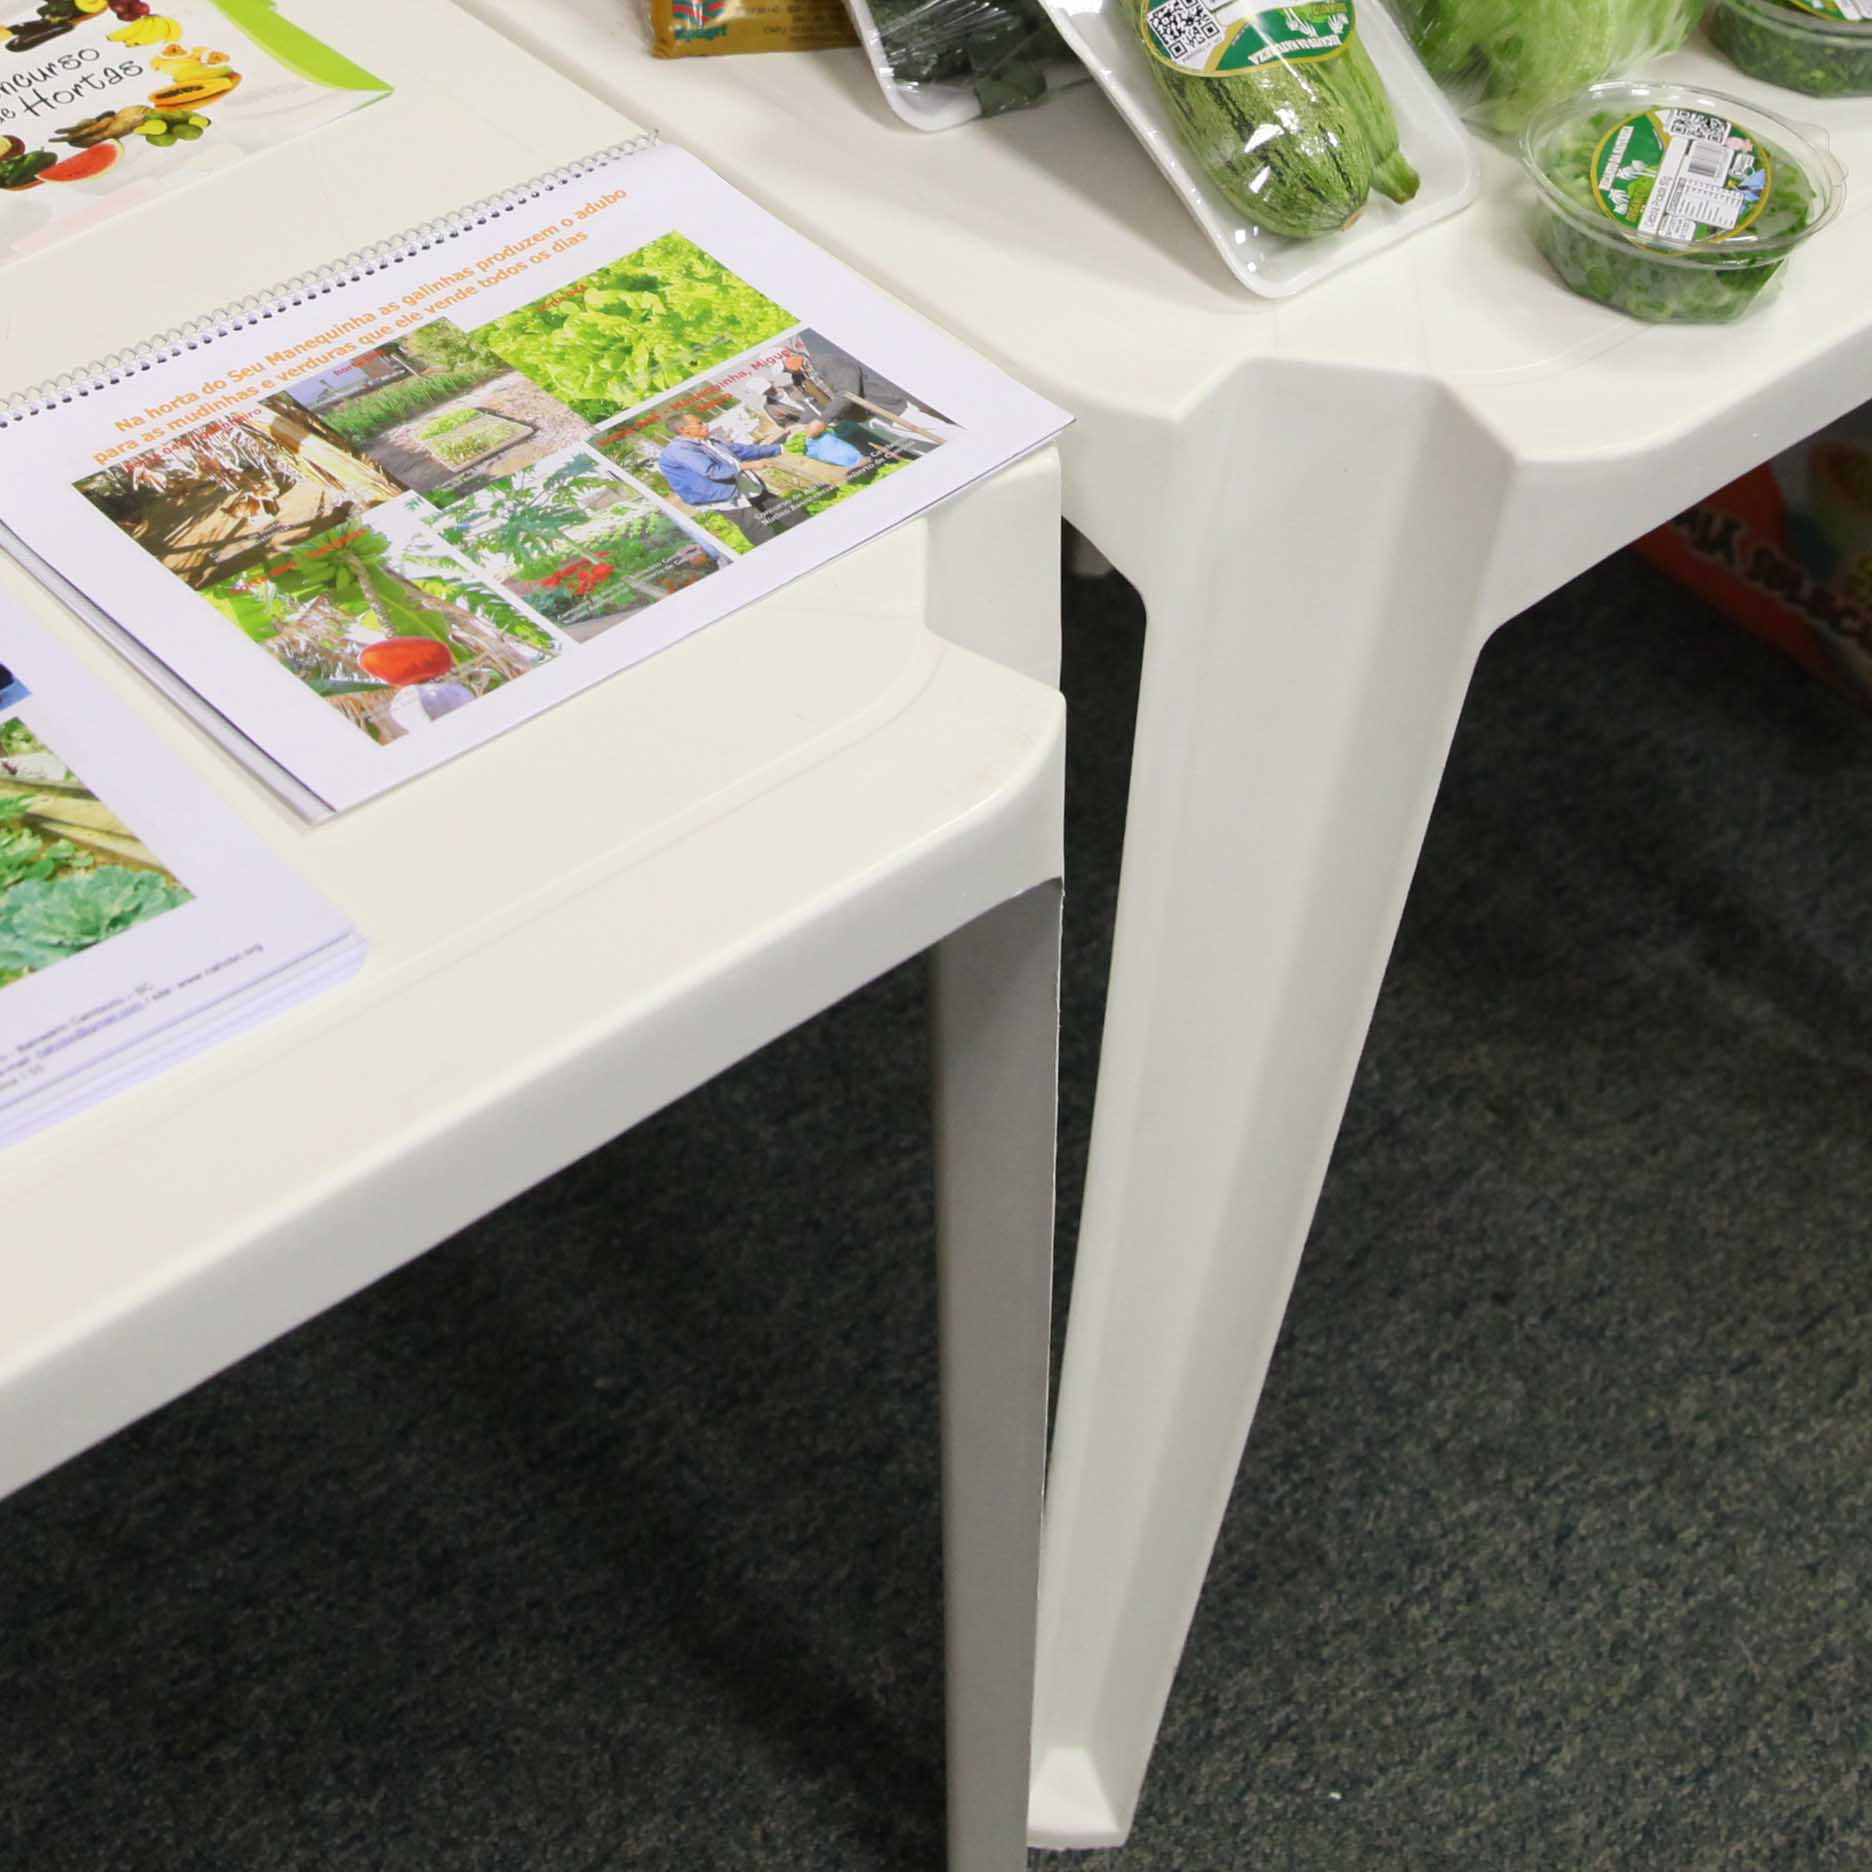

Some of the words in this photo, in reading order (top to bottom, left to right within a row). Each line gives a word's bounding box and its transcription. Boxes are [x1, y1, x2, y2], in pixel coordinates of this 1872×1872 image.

[18, 56, 144, 121] Hortas
[92, 438, 140, 466] para
[142, 427, 166, 444] as
[166, 381, 260, 433] mudinhas
[260, 379, 276, 391] e
[275, 338, 358, 384] verduras
[357, 324, 393, 347] que
[394, 310, 424, 330] ele
[424, 283, 479, 315] vende
[478, 259, 530, 290] todos
[529, 249, 553, 265] os
[551, 230, 590, 255] dias
[114, 413, 146, 434] Na
[145, 386, 201, 419] horta
[201, 378, 228, 396] do
[227, 362, 267, 385] Seu
[265, 311, 376, 366] Manequinha
[378, 300, 402, 317] as
[401, 266, 476, 308] galinhas
[476, 223, 560, 274] produzem
[560, 217, 574, 229] o
[574, 189, 628, 222] adubo
